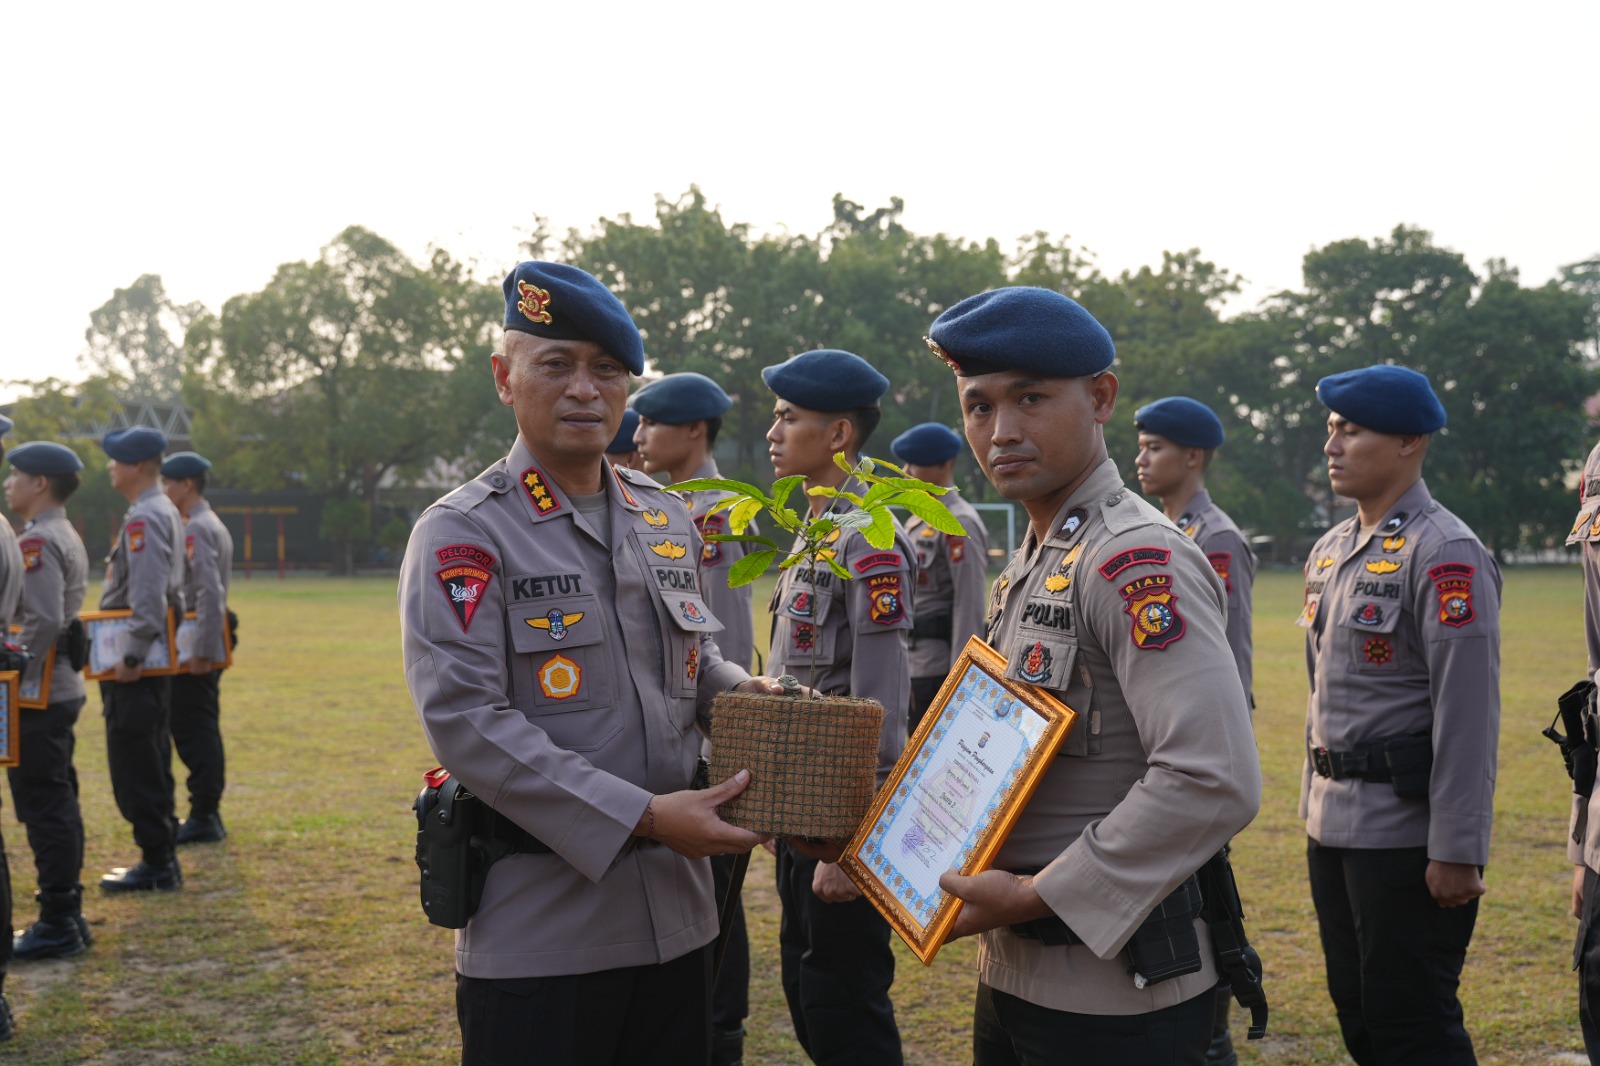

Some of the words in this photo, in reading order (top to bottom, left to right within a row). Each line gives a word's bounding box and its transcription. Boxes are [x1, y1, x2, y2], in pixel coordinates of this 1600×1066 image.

[440, 547, 490, 566] PELOPOR
[512, 574, 581, 600] KETUT
[656, 569, 696, 590] POLRI
[870, 577, 897, 586] RIAU
[1125, 576, 1166, 594] RIAU
[1353, 580, 1400, 600] POLRI
[1021, 602, 1070, 631] POLRI
